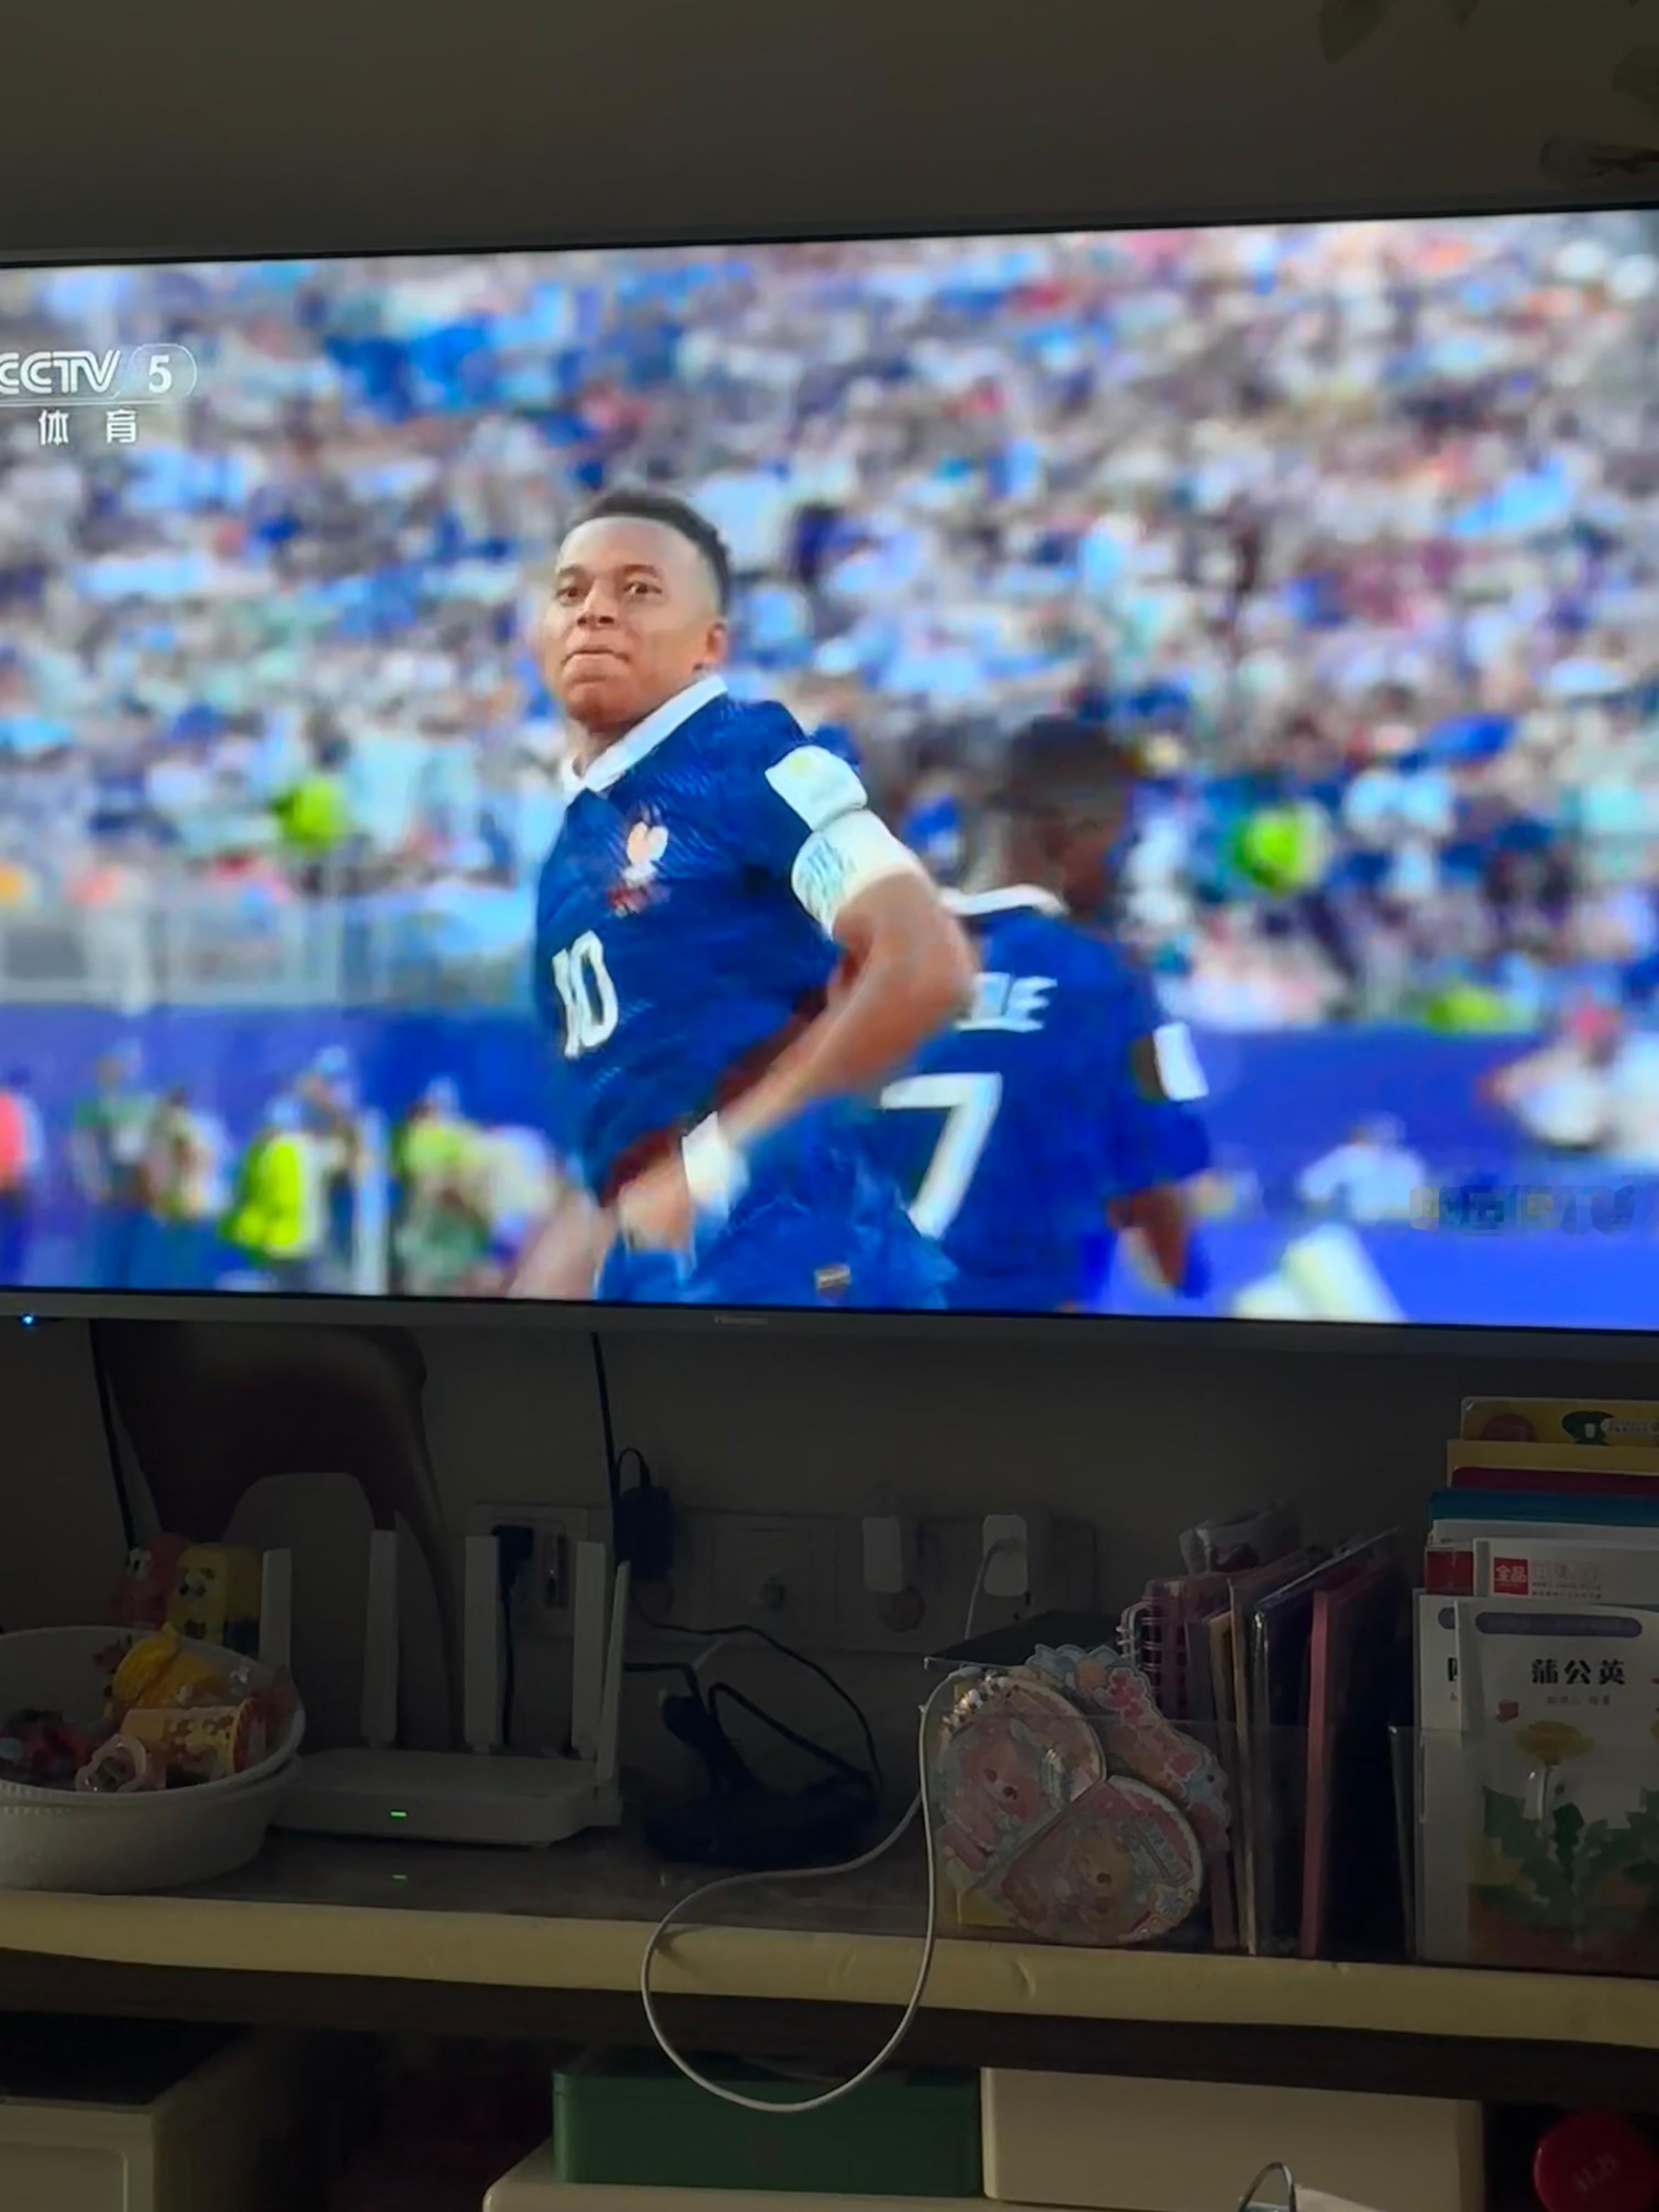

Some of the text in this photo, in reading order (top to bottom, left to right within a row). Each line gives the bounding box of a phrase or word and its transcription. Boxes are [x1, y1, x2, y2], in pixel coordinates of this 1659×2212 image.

[0, 349, 173, 394] CCTV 5
[38, 409, 137, 445] 体育
[552, 929, 619, 1059] 10
[880, 1071, 1003, 1240] 7
[1495, 1564, 1527, 1583] 全品
[1531, 1658, 1626, 1685] 蒲公英
